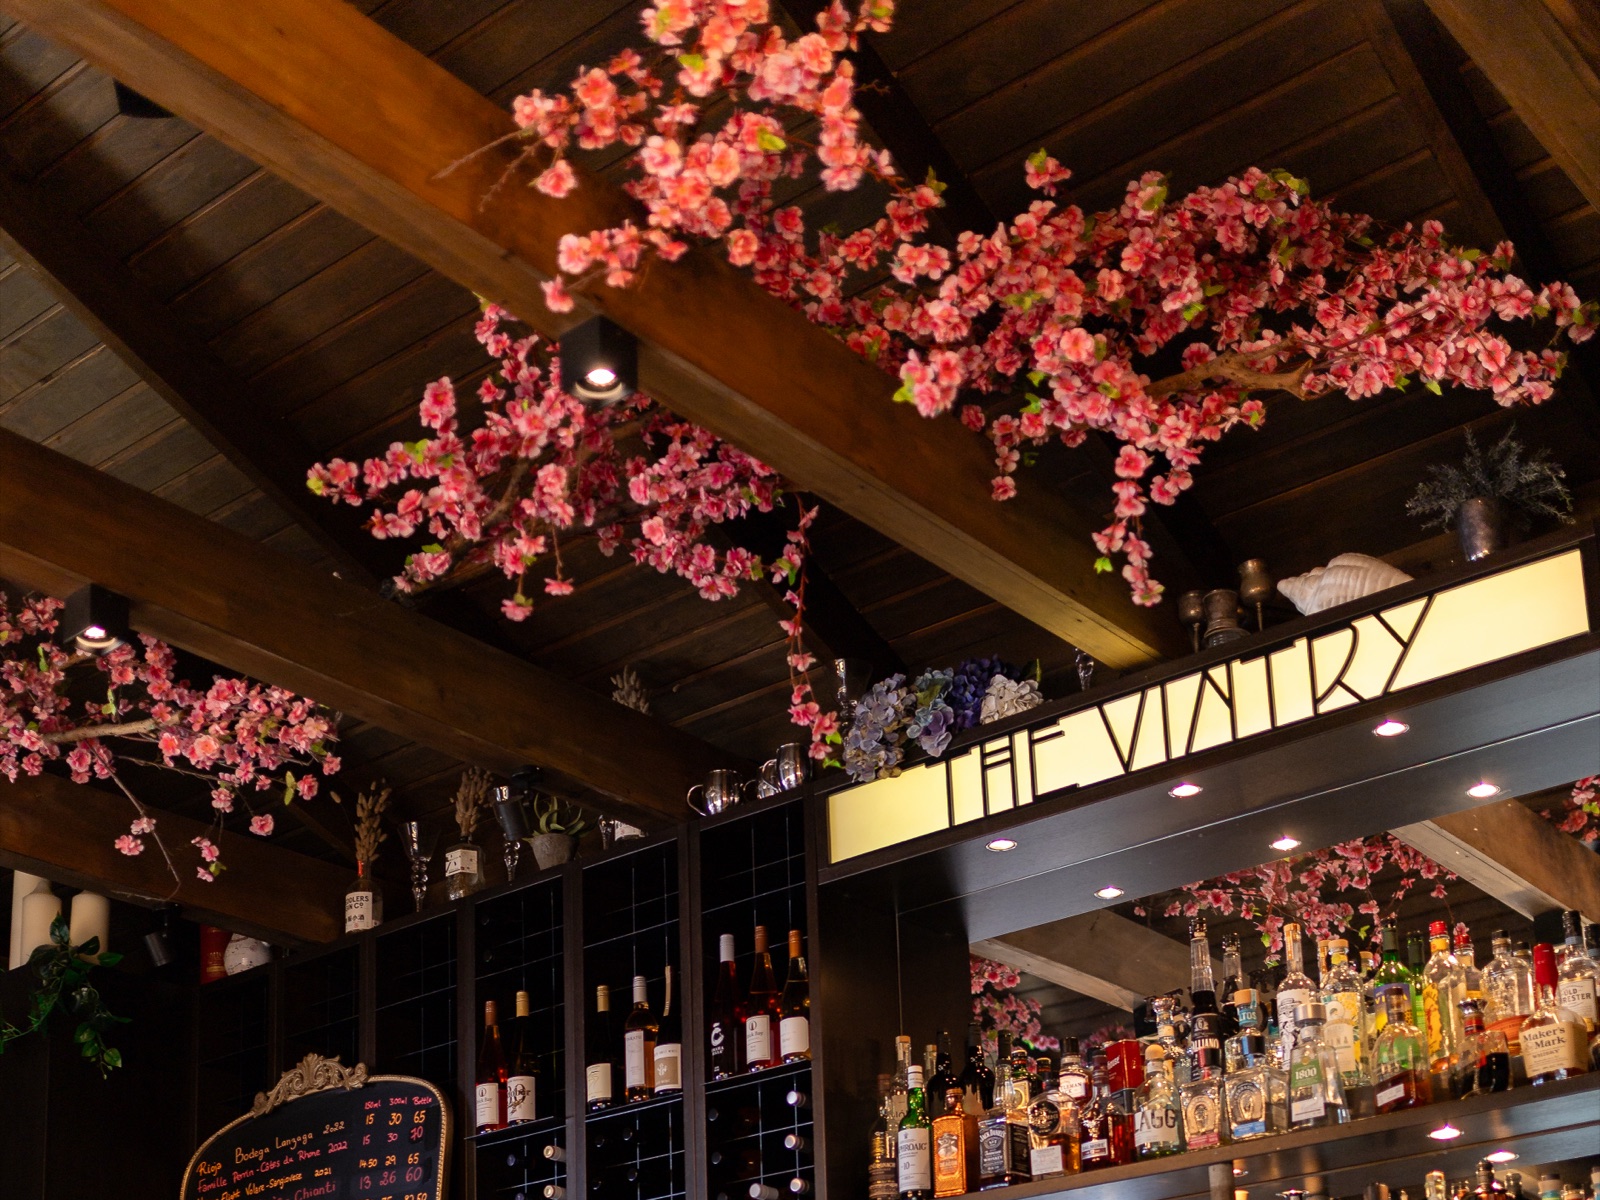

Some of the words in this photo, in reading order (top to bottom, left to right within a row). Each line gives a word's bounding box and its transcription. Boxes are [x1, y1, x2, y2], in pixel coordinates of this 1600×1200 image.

[925, 710, 1080, 828] THE
[1096, 595, 1438, 775] VINTRY
[1561, 993, 1592, 1003] RESTER
[1523, 1026, 1566, 1043] Maker's
[1534, 1036, 1567, 1049] Mark
[1295, 1067, 1317, 1081] 1800
[412, 1096, 432, 1105] Bottle
[196, 1161, 222, 1176] Rioja
[235, 1147, 270, 1164] Bodega
[275, 1132, 313, 1150] Lanzaga
[322, 1121, 345, 1135] 2022
[366, 1113, 375, 1125] 15
[388, 1112, 402, 1126] 30
[413, 1110, 426, 1123] 65
[197, 1176, 227, 1194] Famille
[283, 1155, 294, 1165] du
[328, 1141, 348, 1154] 2022
[362, 1134, 371, 1145] 15
[387, 1132, 398, 1142] 30
[410, 1126, 424, 1140] 70
[314, 1167, 332, 1177] 2021
[385, 1155, 397, 1166] 29
[407, 1152, 420, 1165] 65
[359, 1175, 372, 1190] 13
[380, 1171, 397, 1186] 26
[405, 1167, 423, 1182] 60
